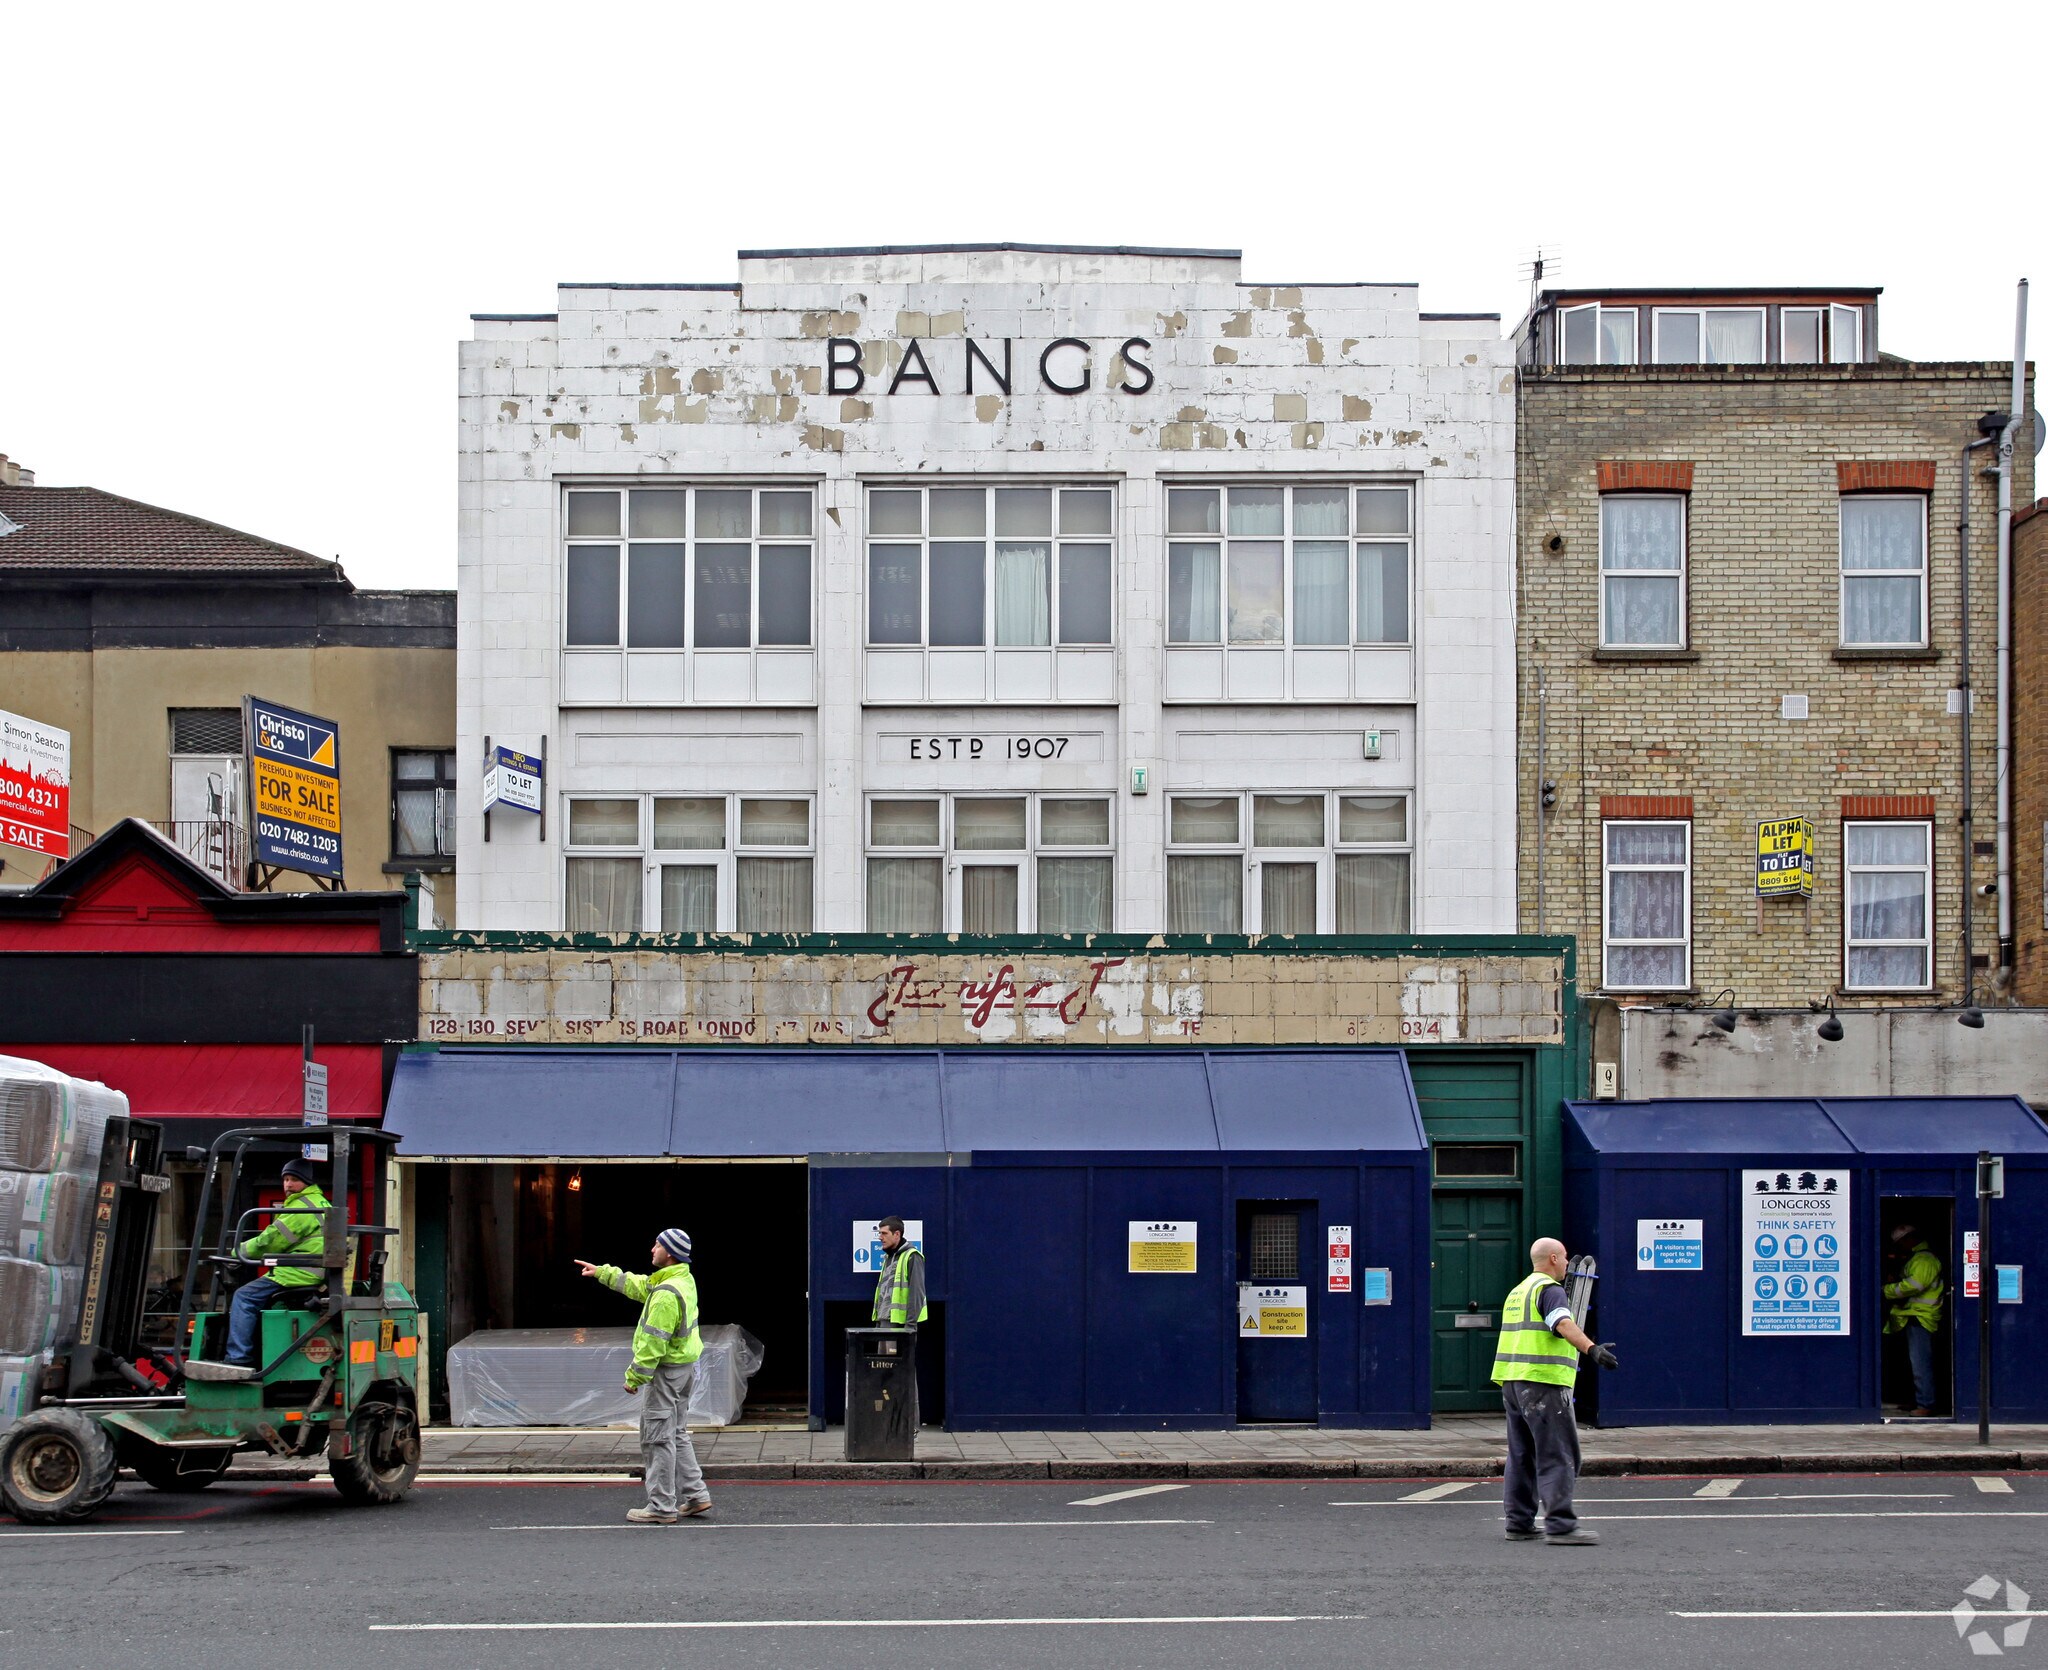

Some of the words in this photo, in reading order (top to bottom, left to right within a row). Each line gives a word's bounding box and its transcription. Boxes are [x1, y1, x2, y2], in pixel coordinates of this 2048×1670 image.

[828, 337, 1154, 396] BANGS
[4, 722, 32, 741] Simon
[34, 732, 65, 751] Seaton
[259, 714, 306, 742] Christo
[260, 731, 285, 751] &Co
[911, 738, 984, 759] ESTD
[1007, 738, 1069, 759] 1907
[23, 744, 29, 753] &
[30, 745, 64, 764] Investment
[512, 752, 526, 763] NEO
[259, 761, 294, 779] FREEHOLD
[295, 772, 335, 790] INVESTMENT
[507, 774, 518, 785] TO
[519, 777, 533, 790] LET
[27, 787, 59, 809] 4321
[259, 775, 293, 803] FOR
[298, 786, 335, 815] SALE
[260, 801, 292, 817] BUSINESS
[293, 809, 306, 820] NOT
[307, 814, 336, 829] AFFECTED
[8, 825, 44, 850] SALE
[260, 821, 281, 839] 020
[284, 827, 310, 846] 7482
[312, 835, 338, 853] 1203
[1762, 820, 1801, 838] ALPHA
[1773, 836, 1793, 850] LET
[271, 844, 329, 865] www.christo.co.uk
[1762, 859, 1778, 871] TO
[1782, 855, 1800, 869] LET
[1760, 878, 1781, 886] 8809
[1783, 874, 1800, 884] 6144
[506, 1020, 546, 1035] SEV
[643, 1021, 688, 1036] ROAD
[1605, 1068, 1612, 1083] Q
[1761, 1199, 1831, 1209] LONGCROSS
[1756, 1220, 1790, 1229] THINK
[1793, 1220, 1836, 1229] SAFETY
[91, 1233, 106, 1286] MOFFETT
[81, 1297, 96, 1341] MOUNTY
[871, 1360, 893, 1369] Litter
